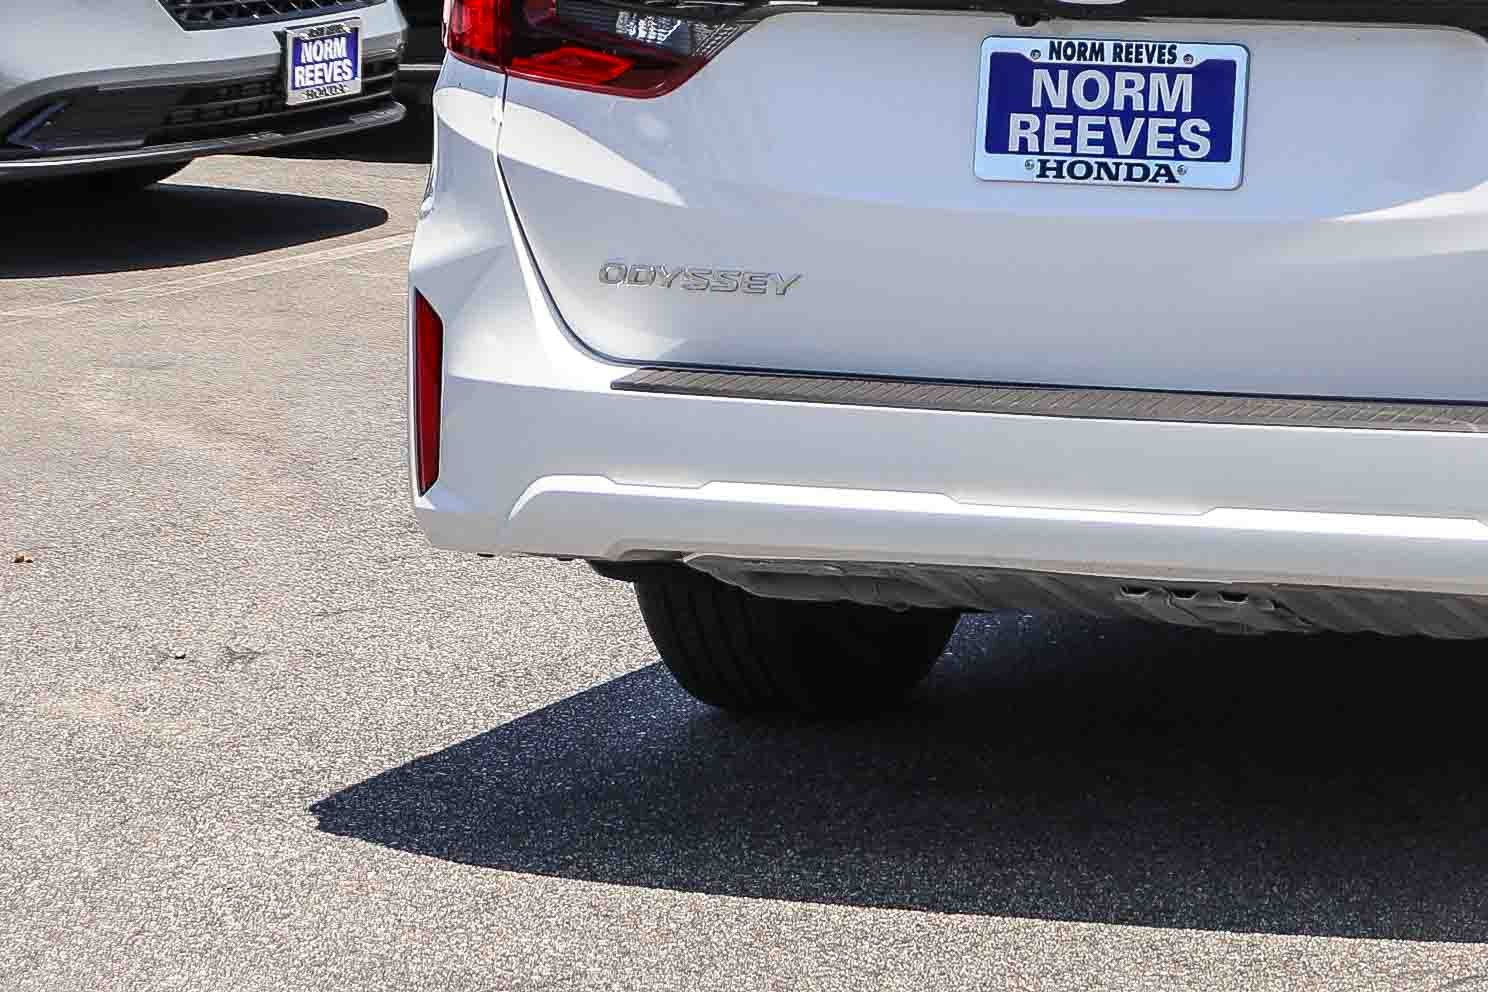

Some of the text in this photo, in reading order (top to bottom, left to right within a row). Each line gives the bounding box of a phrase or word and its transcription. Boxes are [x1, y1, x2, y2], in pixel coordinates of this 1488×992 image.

[301, 37, 347, 63] NORM
[1048, 40, 1177, 65] NORM REEVES
[295, 59, 354, 88] REEVES
[1031, 69, 1193, 112] NORM
[1008, 112, 1211, 159] REEVES
[1036, 159, 1180, 184] HONDA
[598, 262, 804, 296] ODYSSEY
